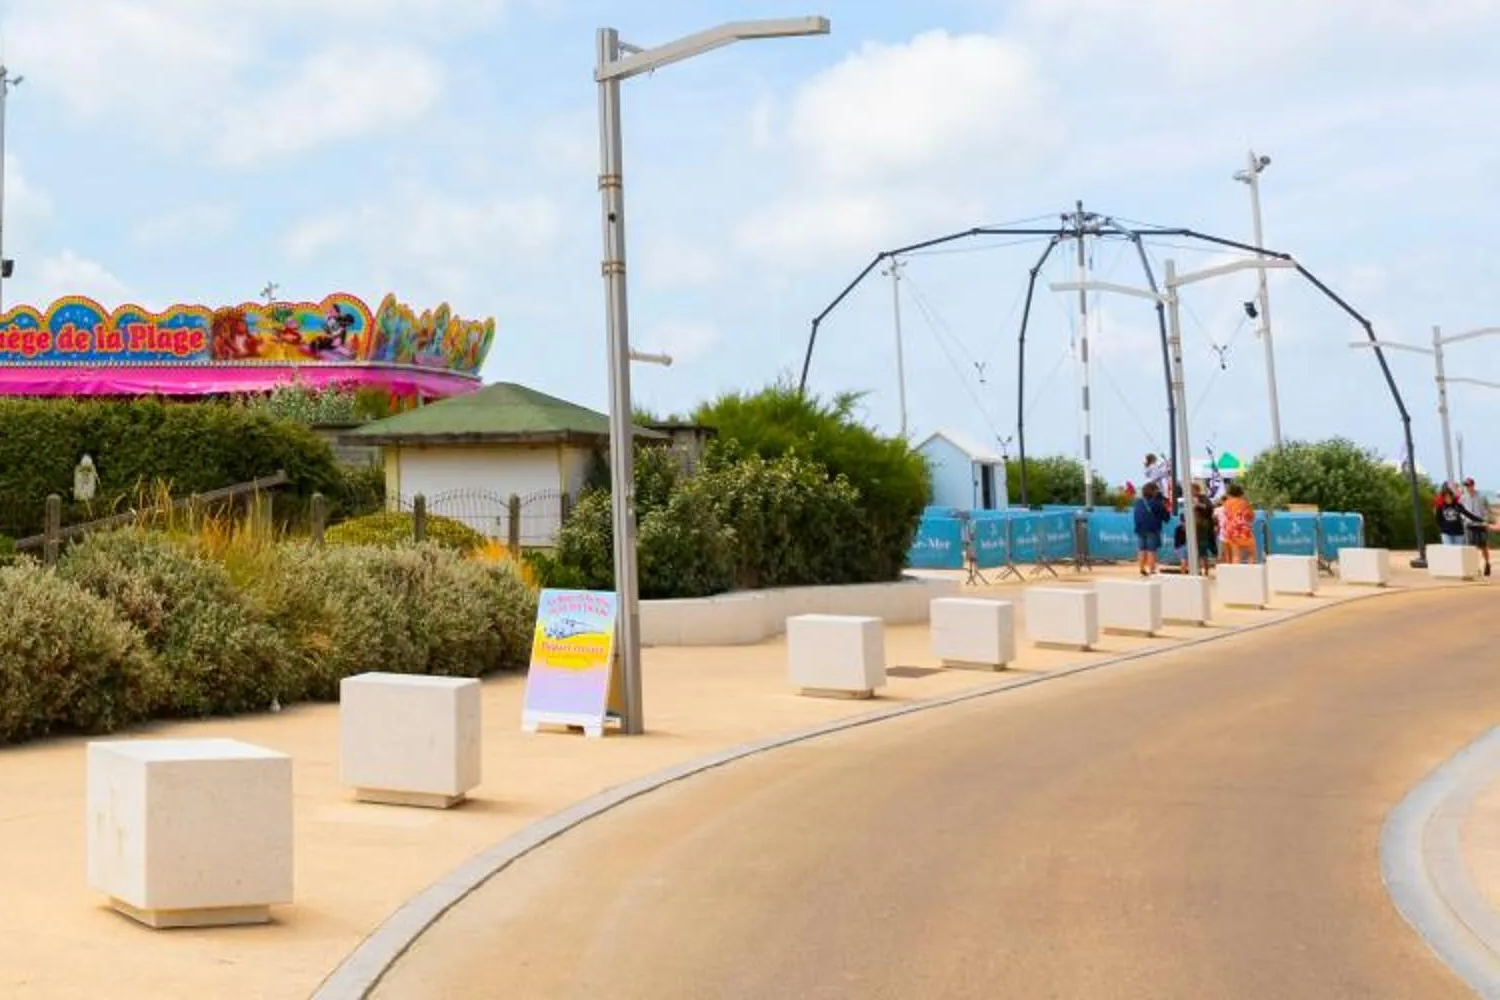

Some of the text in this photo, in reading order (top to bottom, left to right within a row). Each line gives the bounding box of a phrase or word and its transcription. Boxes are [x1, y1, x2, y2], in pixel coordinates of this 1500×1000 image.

[57, 324, 92, 351] de
[94, 324, 123, 351] la
[128, 324, 205, 356] Plage
